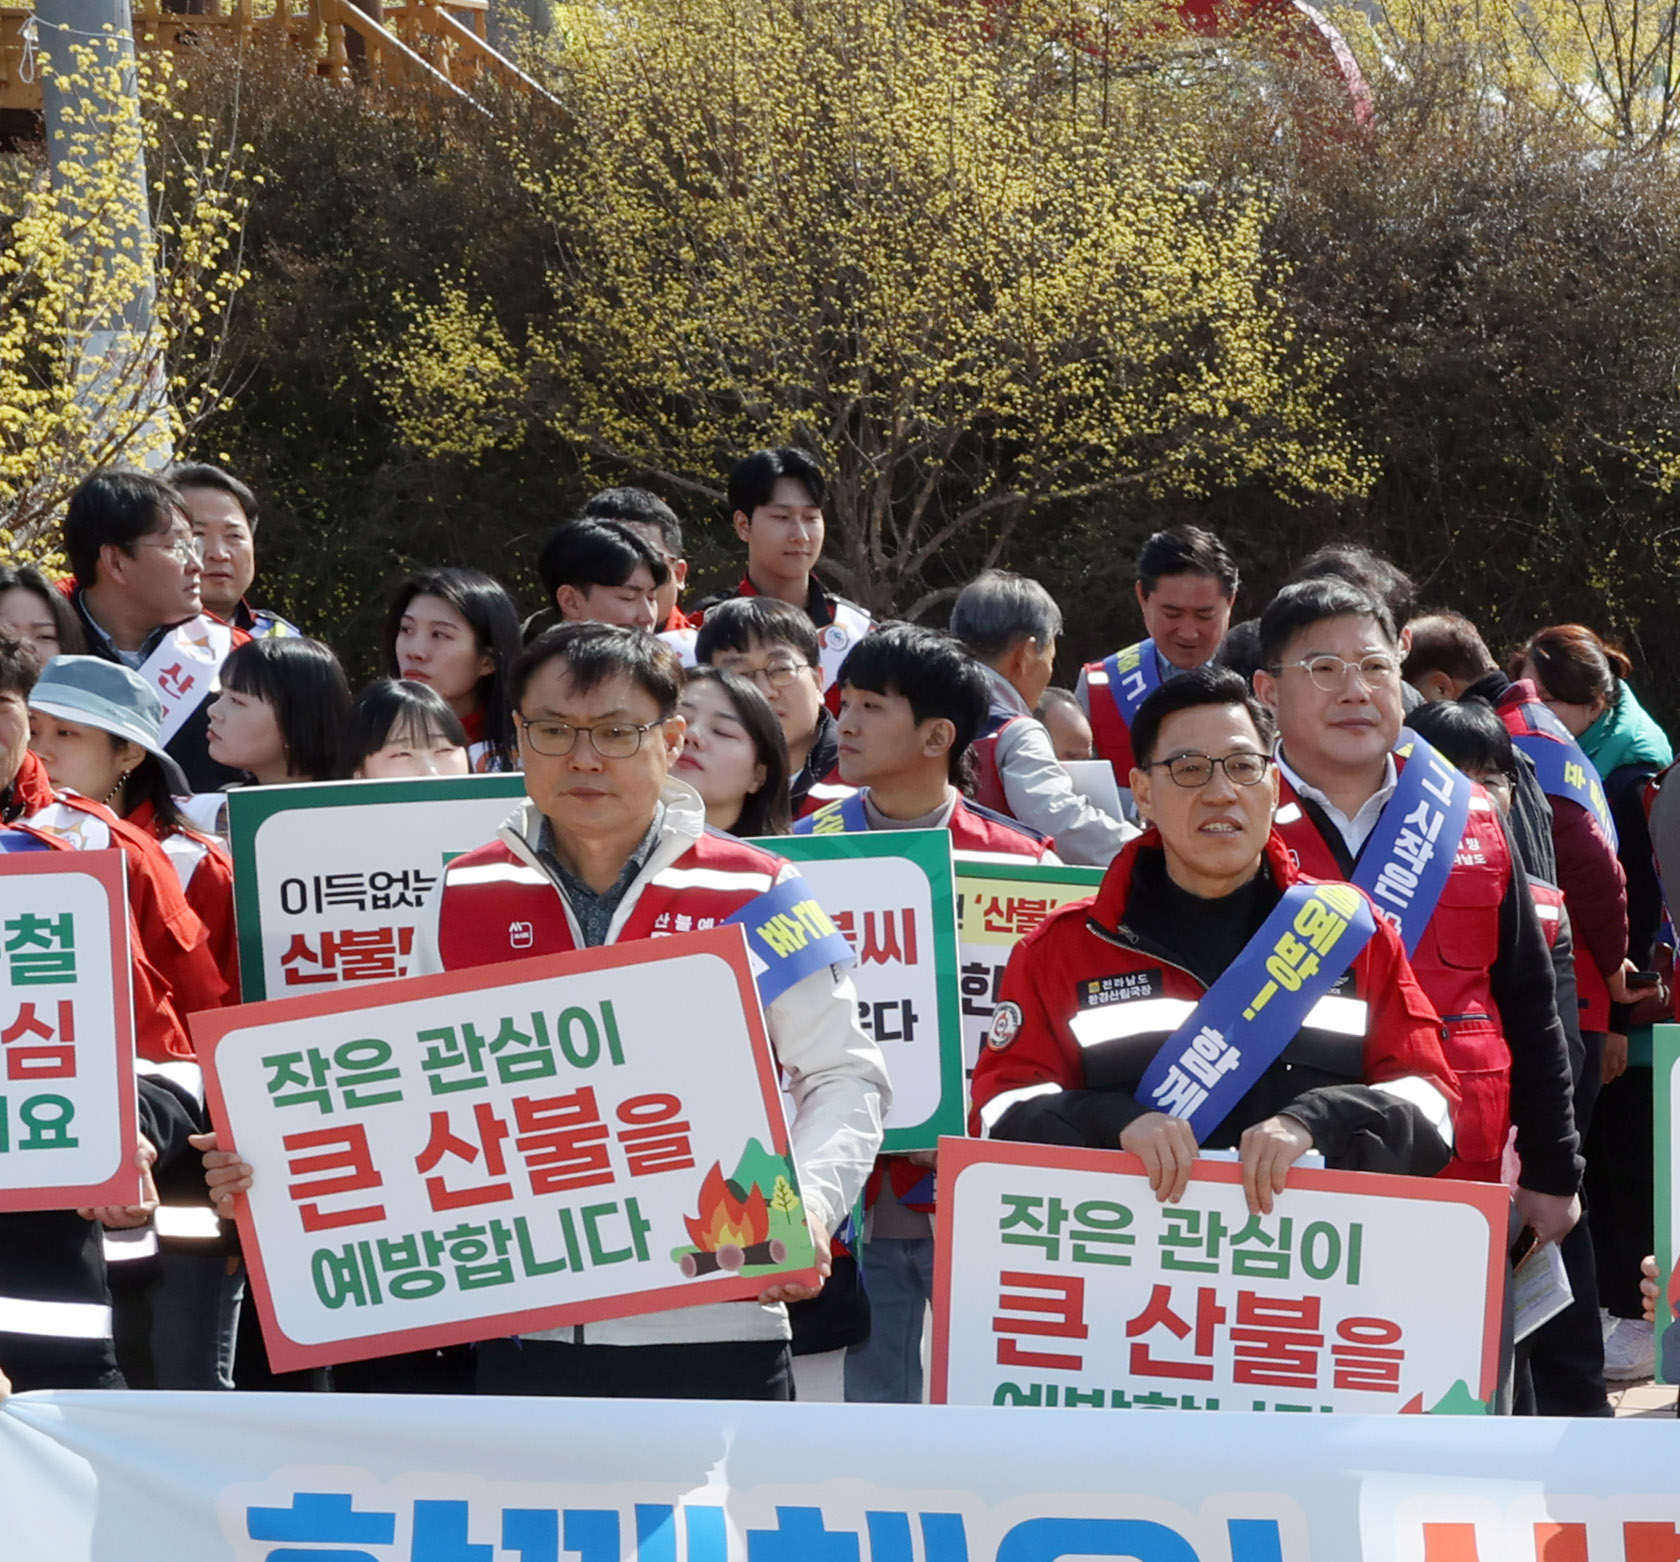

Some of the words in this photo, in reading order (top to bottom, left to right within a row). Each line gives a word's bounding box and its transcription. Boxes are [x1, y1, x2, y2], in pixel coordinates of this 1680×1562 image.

[0, 912, 78, 986] 철
[280, 925, 415, 985] 산불!
[654, 911, 724, 932] 산불예
[1101, 973, 1149, 990] 전라남도
[261, 1037, 404, 1116] 작은
[415, 999, 626, 1098] 관심이
[281, 1122, 388, 1234] 큰
[414, 1086, 697, 1214] 산불을
[310, 1196, 654, 1311] 예방합니다
[998, 1193, 1137, 1268] 작은
[1157, 1206, 1364, 1286] 관심이
[991, 1270, 1090, 1371] 큰
[1124, 1282, 1407, 1393] 산불을
